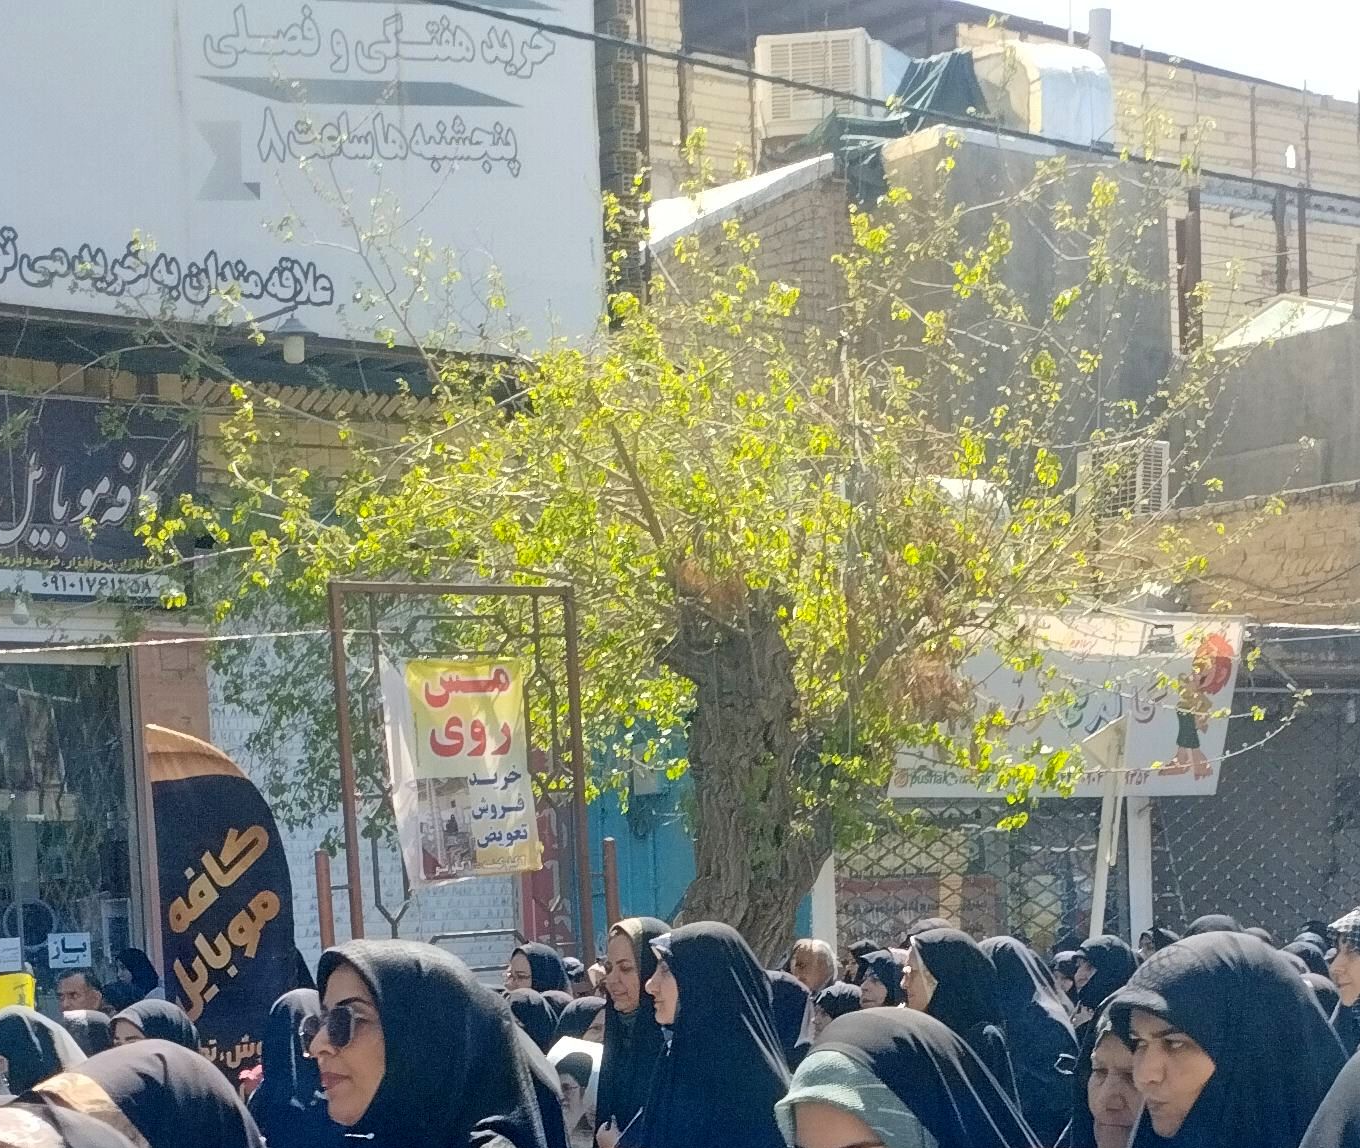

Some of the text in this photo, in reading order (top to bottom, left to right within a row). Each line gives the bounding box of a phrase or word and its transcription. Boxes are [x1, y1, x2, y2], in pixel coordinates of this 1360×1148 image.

[203, 3, 555, 79] خرید هفتگی و فصلی
[257, 106, 287, 163] ۸
[408, 115, 521, 178] پنجشنبه
[71, 238, 149, 296] خرید
[423, 667, 512, 709] مس
[429, 715, 513, 758] روی
[468, 764, 523, 791] خرید
[471, 792, 526, 821] فروش
[476, 823, 529, 849] تعویض
[168, 824, 270, 934] کافه
